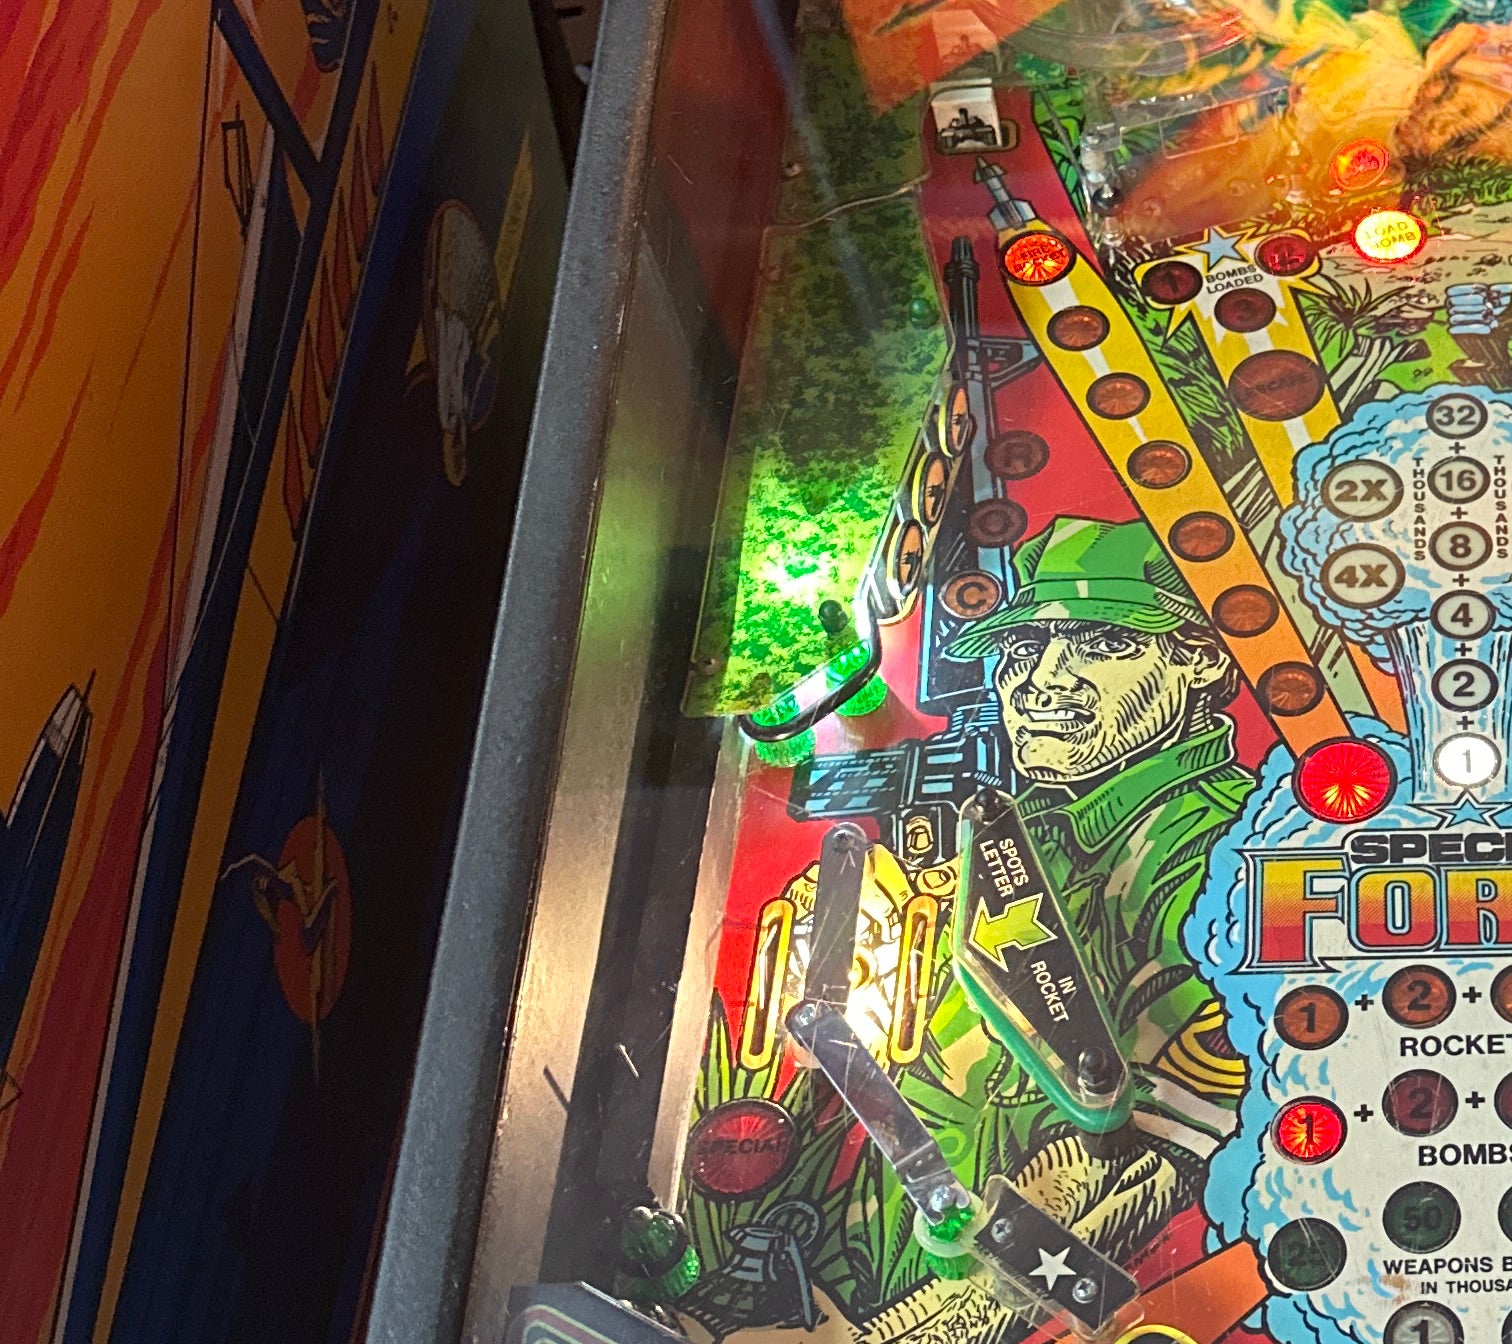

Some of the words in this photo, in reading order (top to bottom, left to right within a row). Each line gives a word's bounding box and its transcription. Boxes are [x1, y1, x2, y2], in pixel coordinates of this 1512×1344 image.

[1205, 265, 1257, 284] BOMBS
[1206, 273, 1264, 295] LOADED
[1436, 405, 1477, 426] 32
[1335, 479, 1389, 503] 2X
[1440, 469, 1476, 492] 16
[1413, 456, 1426, 561] THOUSANDS
[1494, 455, 1509, 559] THOUSANDS
[1450, 534, 1472, 558] 8
[1335, 564, 1390, 588] 4X
[1450, 603, 1473, 628] 4
[1453, 671, 1475, 697] 2
[979, 839, 1014, 898] LETTER
[999, 837, 1029, 887] SPOTS
[1030, 961, 1069, 1023] ROCKET
[1407, 980, 1433, 1011] 2
[1383, 1257, 1494, 1276] WEAPONS
[1420, 1281, 1438, 1295] IN
